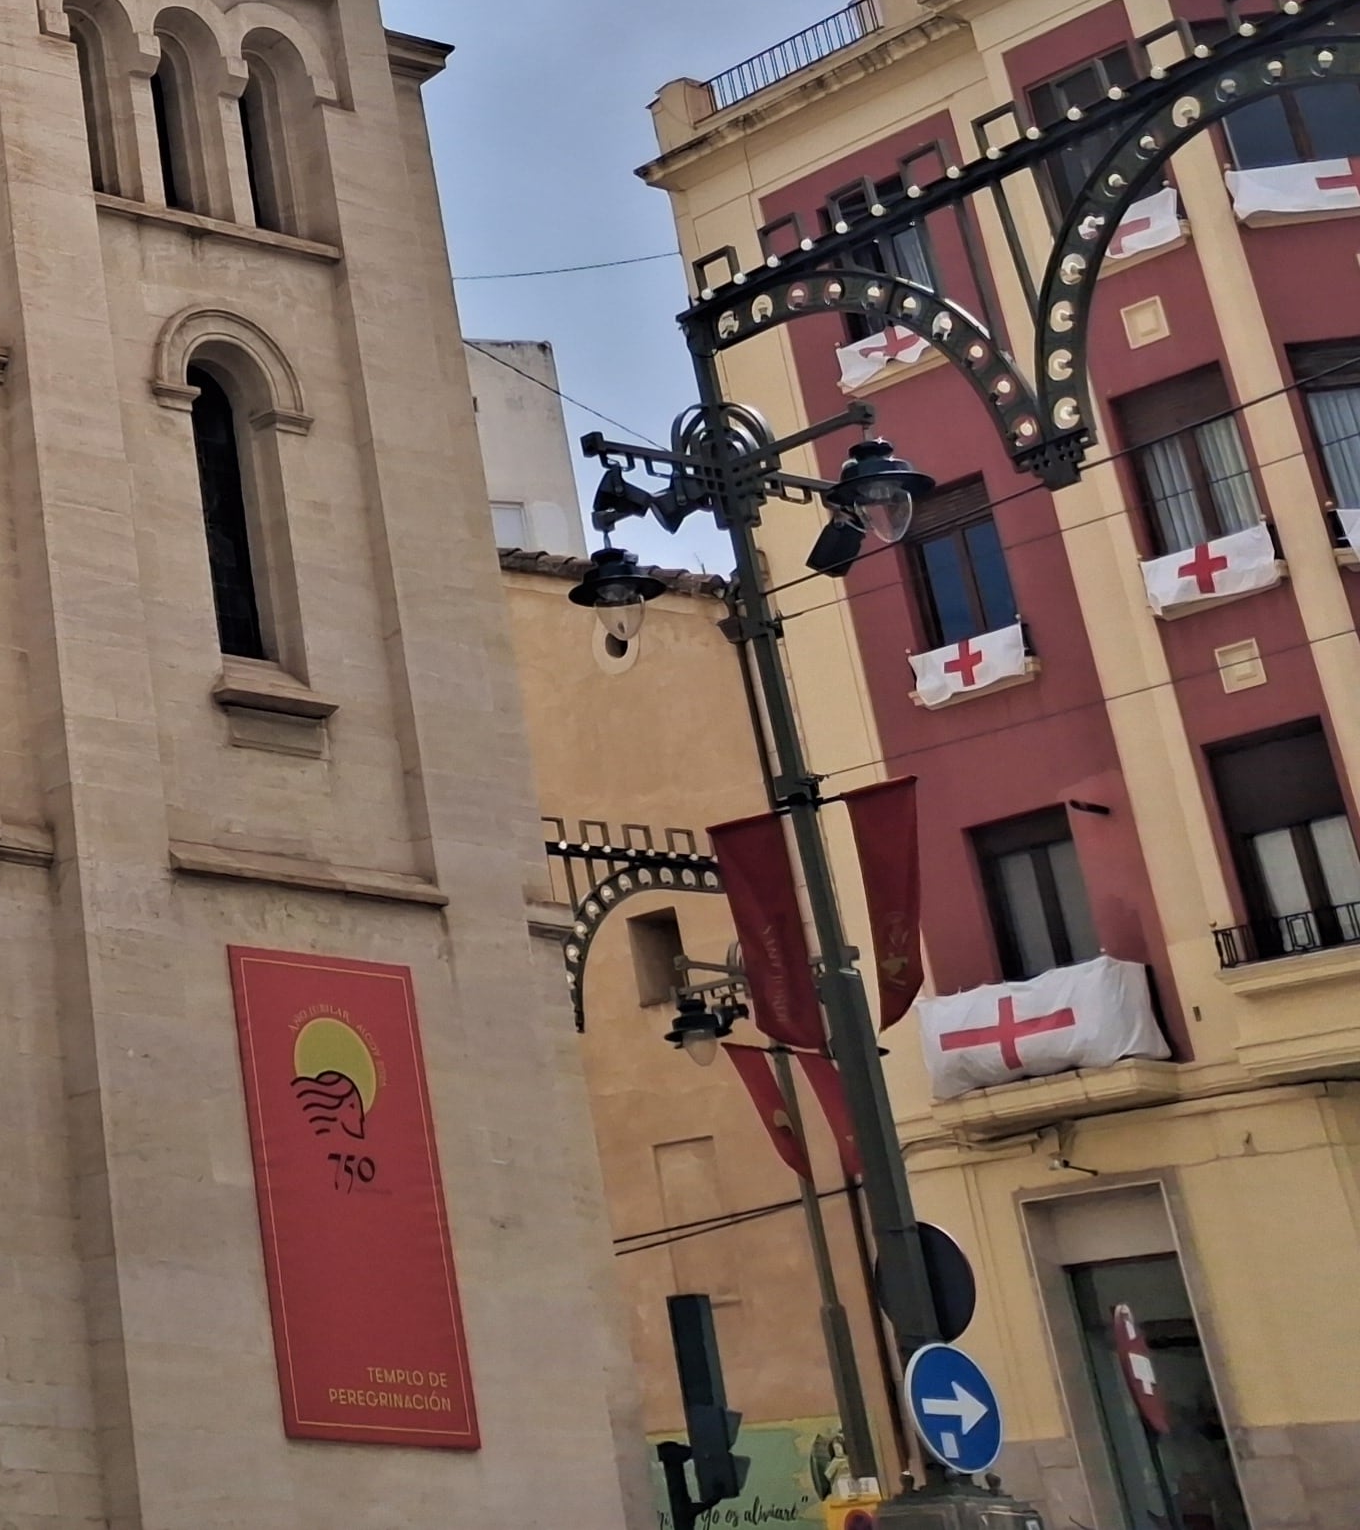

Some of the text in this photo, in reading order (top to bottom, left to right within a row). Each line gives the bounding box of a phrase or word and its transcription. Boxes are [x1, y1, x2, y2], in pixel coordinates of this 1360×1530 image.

[327, 1153, 376, 1195] 750
[366, 1366, 448, 1388] TEMPLO DE
[328, 1387, 451, 1412] PEREGRINACIÓN
